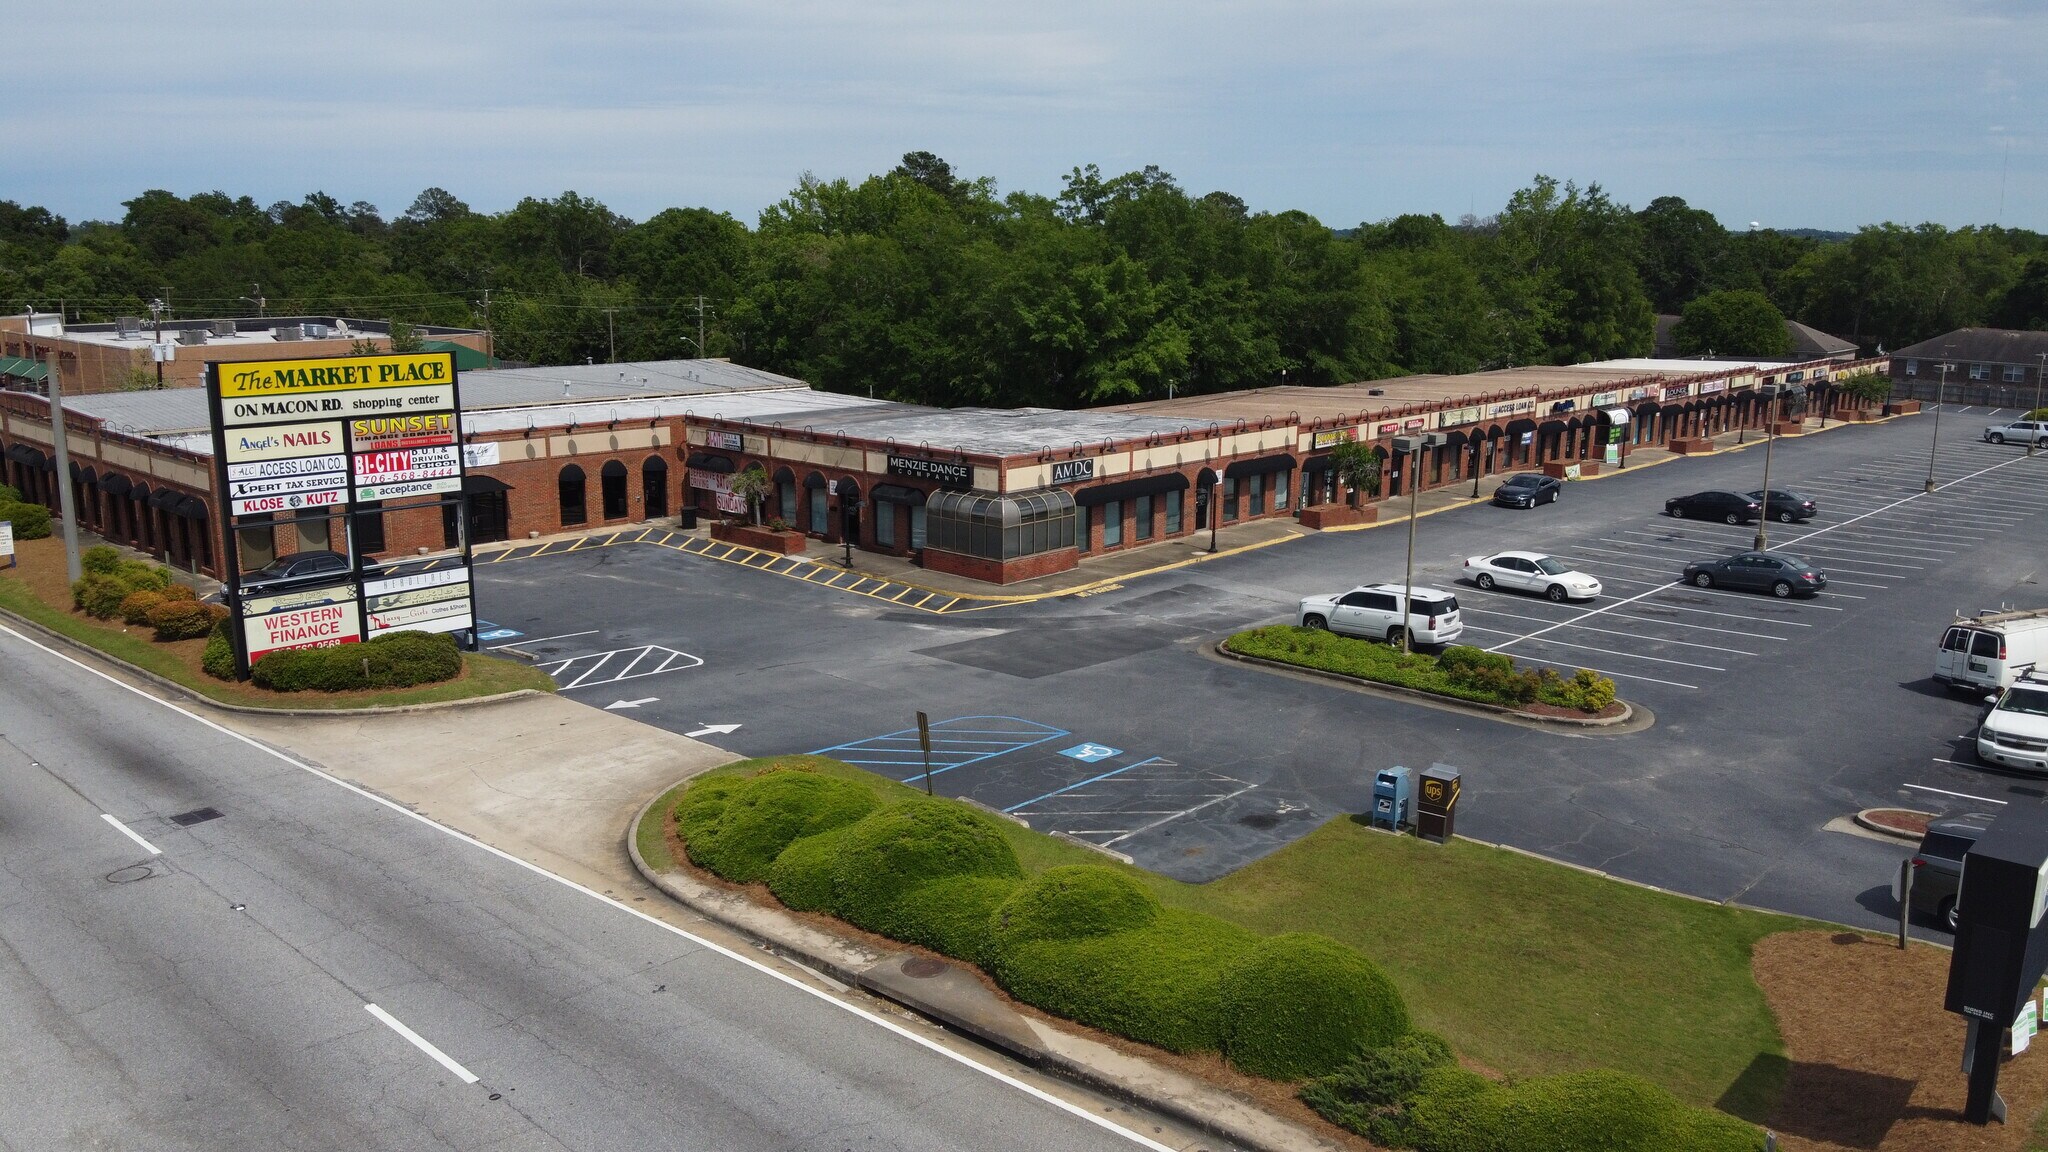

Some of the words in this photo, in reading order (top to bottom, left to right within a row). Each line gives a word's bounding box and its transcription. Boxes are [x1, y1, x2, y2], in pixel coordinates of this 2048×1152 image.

[233, 370, 273, 391] The
[273, 365, 372, 388] MARKET
[378, 362, 445, 382] PLACE
[234, 403, 258, 417] ON
[262, 399, 318, 415] MACON
[321, 398, 343, 411] RD.
[353, 397, 402, 409] shopping
[408, 394, 440, 405] center
[353, 413, 453, 437] SUNSET
[402, 429, 455, 437] COMPANY
[283, 431, 332, 447] NAILS
[370, 440, 399, 450] LOANS
[259, 461, 297, 476] ACCESS
[299, 458, 326, 473] LOAN
[327, 457, 344, 470] CO.
[353, 450, 410, 474] BI-CITY
[411, 454, 450, 462] DRIVING
[412, 460, 456, 469] SCHOOL
[890, 457, 928, 471] MENZIE
[930, 463, 967, 477] DANCE
[363, 468, 453, 484] 706-568-8444
[898, 469, 959, 482] COMPANY
[1055, 460, 1092, 479] AMDC
[285, 480, 304, 489] TAX
[306, 476, 345, 487] SERVICE
[379, 482, 433, 496] acceptance
[243, 497, 284, 512] KLOSE
[306, 491, 338, 506] KUTZ
[716, 495, 748, 514] SUNDAYS
[263, 606, 343, 630] WESTERN
[270, 621, 340, 644] FINANCE
[1426, 786, 1441, 797] ups
